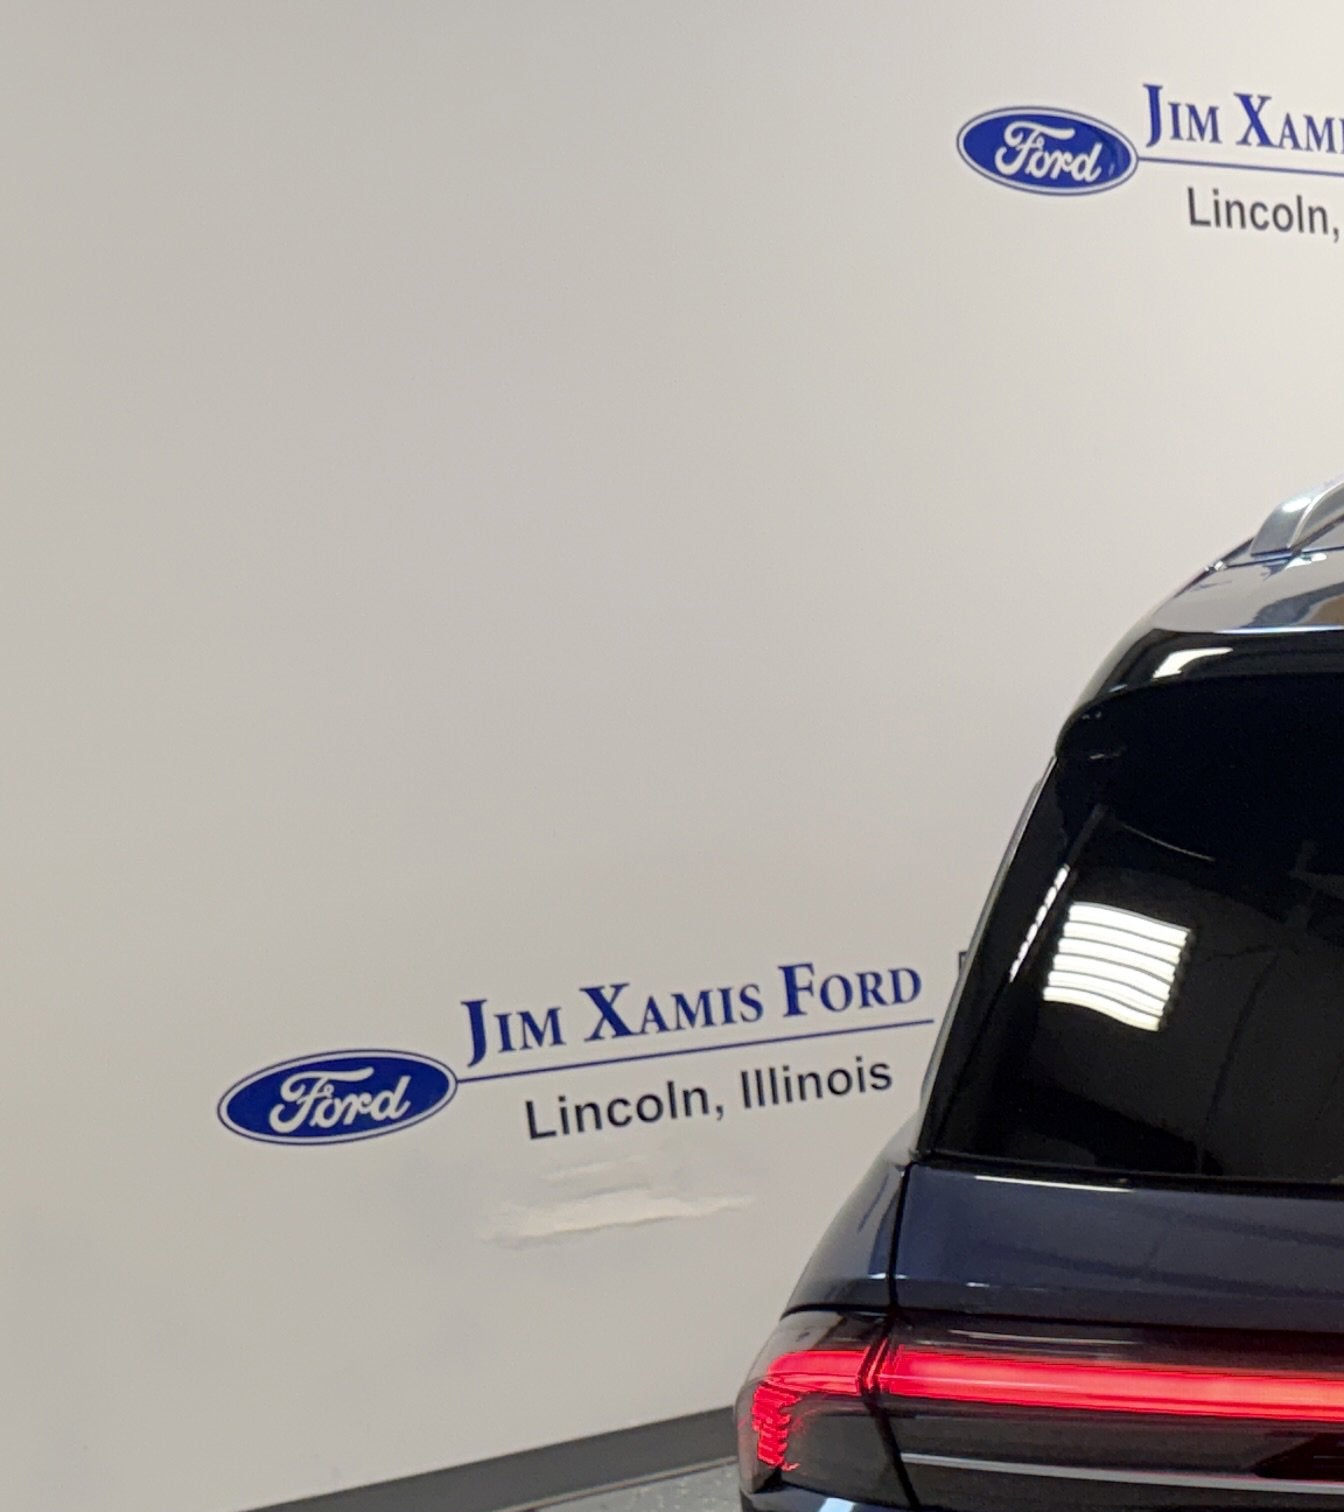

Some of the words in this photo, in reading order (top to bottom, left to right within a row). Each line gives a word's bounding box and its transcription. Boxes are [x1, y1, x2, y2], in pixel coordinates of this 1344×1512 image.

[1143, 84, 1222, 148] JIM
[995, 120, 1101, 183] Ford
[1187, 187, 1340, 243] Lincoln,
[461, 999, 567, 1067] JIM
[579, 982, 763, 1042] XAMIS
[778, 962, 922, 1017] FORD
[269, 1068, 410, 1132] Ford
[525, 1081, 724, 1140] Lincoln,
[741, 1056, 892, 1109] Illinois
